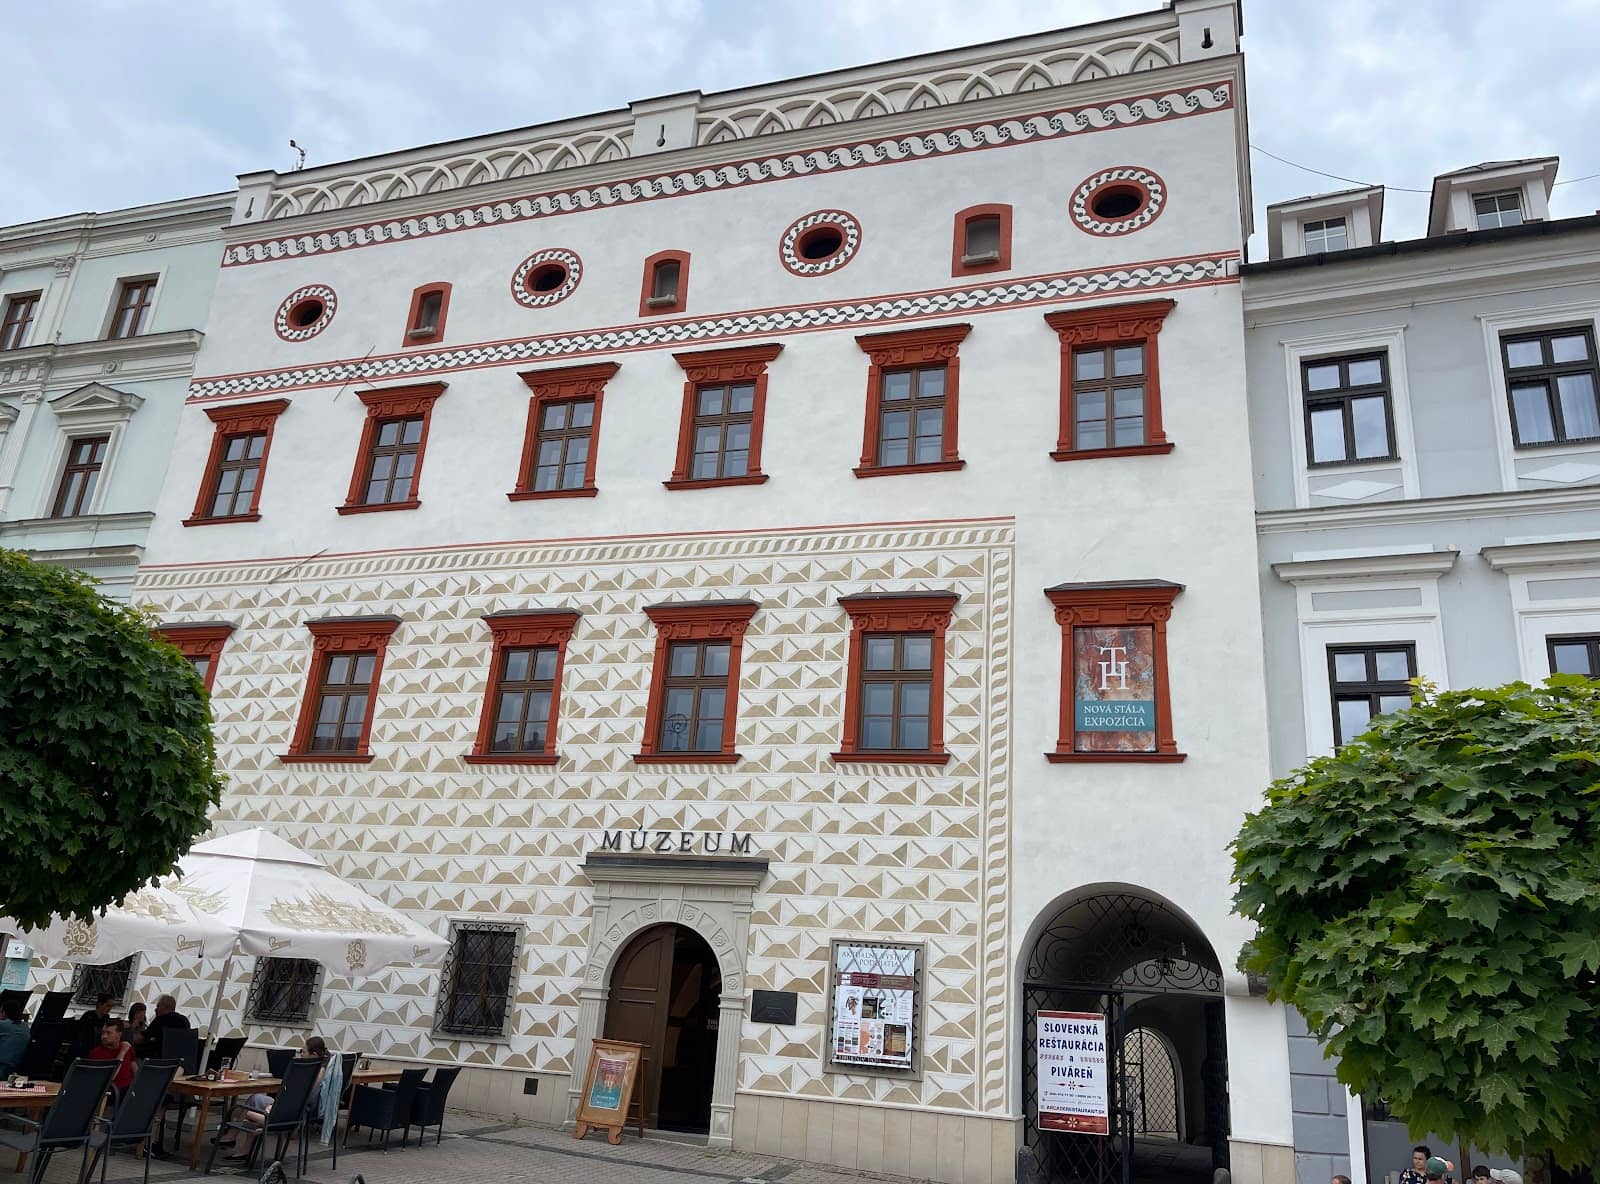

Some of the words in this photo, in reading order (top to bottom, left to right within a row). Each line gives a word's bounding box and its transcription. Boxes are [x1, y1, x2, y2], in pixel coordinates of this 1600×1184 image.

[1084, 704, 1112, 714] NOVÁ
[1114, 703, 1145, 714] STÁLA
[1084, 716, 1146, 727] EXPOZÍCIA
[600, 824, 751, 854] MÚZEUM
[1044, 1022, 1098, 1035] SLOVENSKÁ
[1039, 1037, 1105, 1052] REŠTAURÁCIA
[1051, 1066, 1093, 1079] PIVÁREŇ
